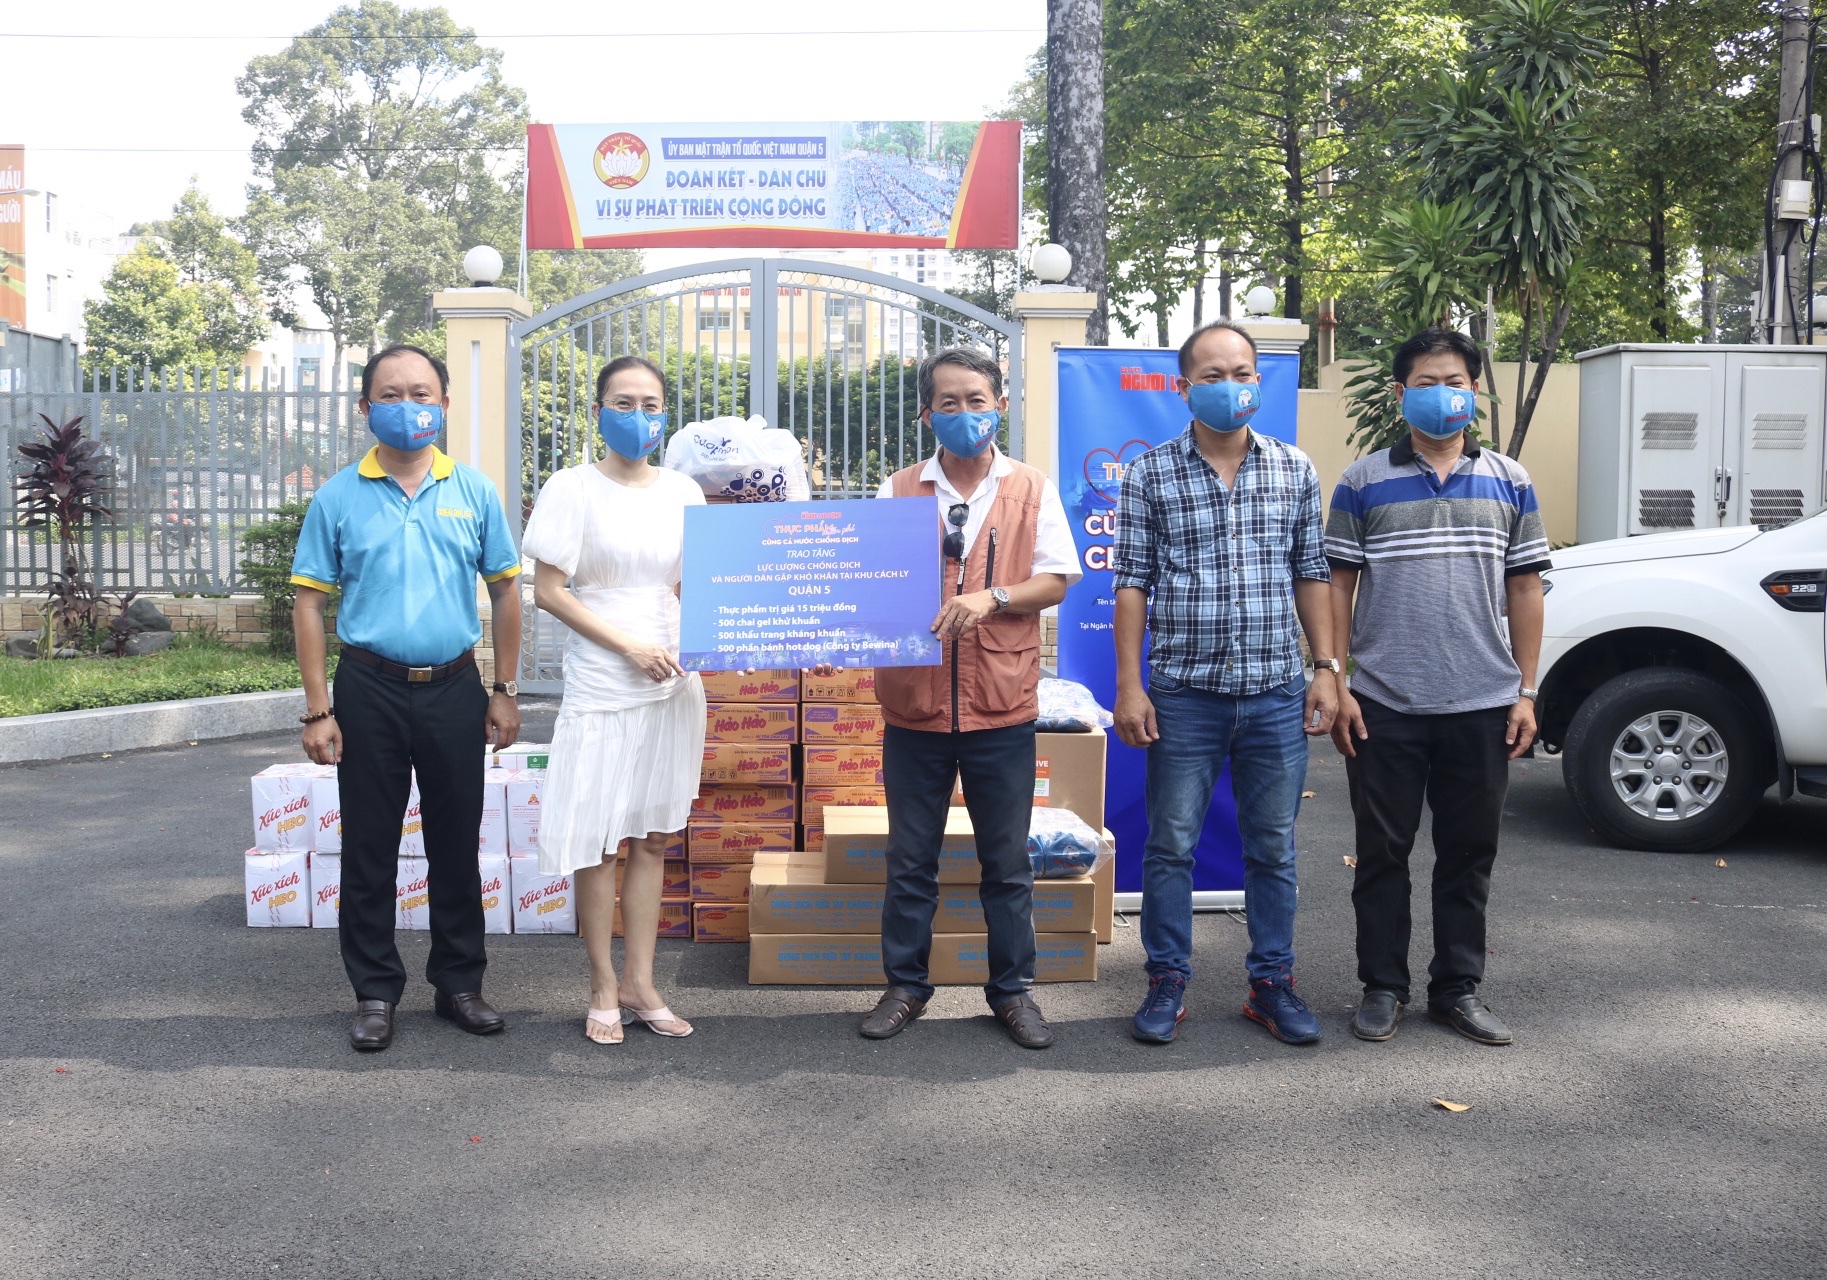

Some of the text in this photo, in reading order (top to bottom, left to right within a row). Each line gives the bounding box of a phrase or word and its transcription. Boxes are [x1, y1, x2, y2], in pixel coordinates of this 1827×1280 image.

[668, 139, 824, 157] ỦY BAN MẶT TRẬN TỔ QUỐC VIỆT NAM QUẬN 5
[717, 167, 745, 188] KẾT
[796, 166, 826, 188] CHỦ
[615, 197, 633, 219] SỰ
[681, 194, 724, 217] TRIỂN
[728, 197, 774, 220] CỘNG
[778, 195, 826, 217] ĐỒNG
[774, 524, 802, 535] THỰC
[762, 536, 859, 546] CÙNG CẢ NƯỚC CHỐNG DỊCH
[786, 548, 836, 560] TRAO TẶNG
[757, 560, 861, 573] LỰC LƯỢNG CHỐNG DỊCH
[711, 575, 722, 583] VÀ
[724, 573, 753, 583] NGƯỜI
[754, 573, 773, 582] DÂN
[774, 572, 792, 583] GẶP
[793, 571, 812, 581] KHÓ
[839, 572, 852, 581] TẠI
[854, 571, 872, 579] KHU
[874, 570, 897, 578] CÁCH
[899, 570, 909, 578] LY
[788, 583, 831, 597] QUẬN 5
[718, 606, 740, 615] Thực
[741, 604, 767, 615] phẩm
[768, 605, 779, 615] trị
[780, 604, 795, 615] giá
[797, 604, 808, 612] 15
[809, 603, 831, 614] triệu
[833, 602, 857, 613] đồng
[1097, 597, 1108, 606] Tên
[718, 619, 735, 627] 500
[736, 618, 756, 626] chai
[757, 618, 771, 628] gel
[772, 616, 791, 626] khử
[791, 615, 820, 625] khuẩn
[1080, 622, 1107, 631] Tại Ngân
[718, 631, 735, 640] 500
[736, 629, 759, 639] khẩu
[760, 631, 785, 641] trang
[787, 630, 816, 640] kháng
[817, 627, 846, 638] khuẩn
[717, 644, 735, 653] 500
[736, 642, 759, 653] phần
[761, 643, 784, 651] bánh
[786, 643, 801, 651] hot
[802, 641, 821, 652] dog
[823, 640, 850, 651] (Công
[851, 641, 861, 652] ty
[862, 639, 899, 650] Bewina)
[739, 680, 779, 695] Hảo Hảo
[714, 714, 766, 732] Hảo Hảo
[737, 755, 782, 771] Hảo Hảo
[838, 756, 880, 771] Hảo Hảo
[713, 792, 766, 811] Hảo Hảo
[259, 795, 309, 831] Xúc xích
[277, 814, 306, 834] HEO
[722, 833, 764, 849] Hảo Hảo
[251, 872, 300, 905] Xúc xích
[482, 877, 502, 894] ích
[269, 890, 297, 909] HEO
[317, 884, 340, 906] Xúc
[401, 893, 429, 911] HEO
[519, 877, 570, 912] Xúc xích
[482, 896, 498, 911] EO
[537, 897, 566, 915] HEO
